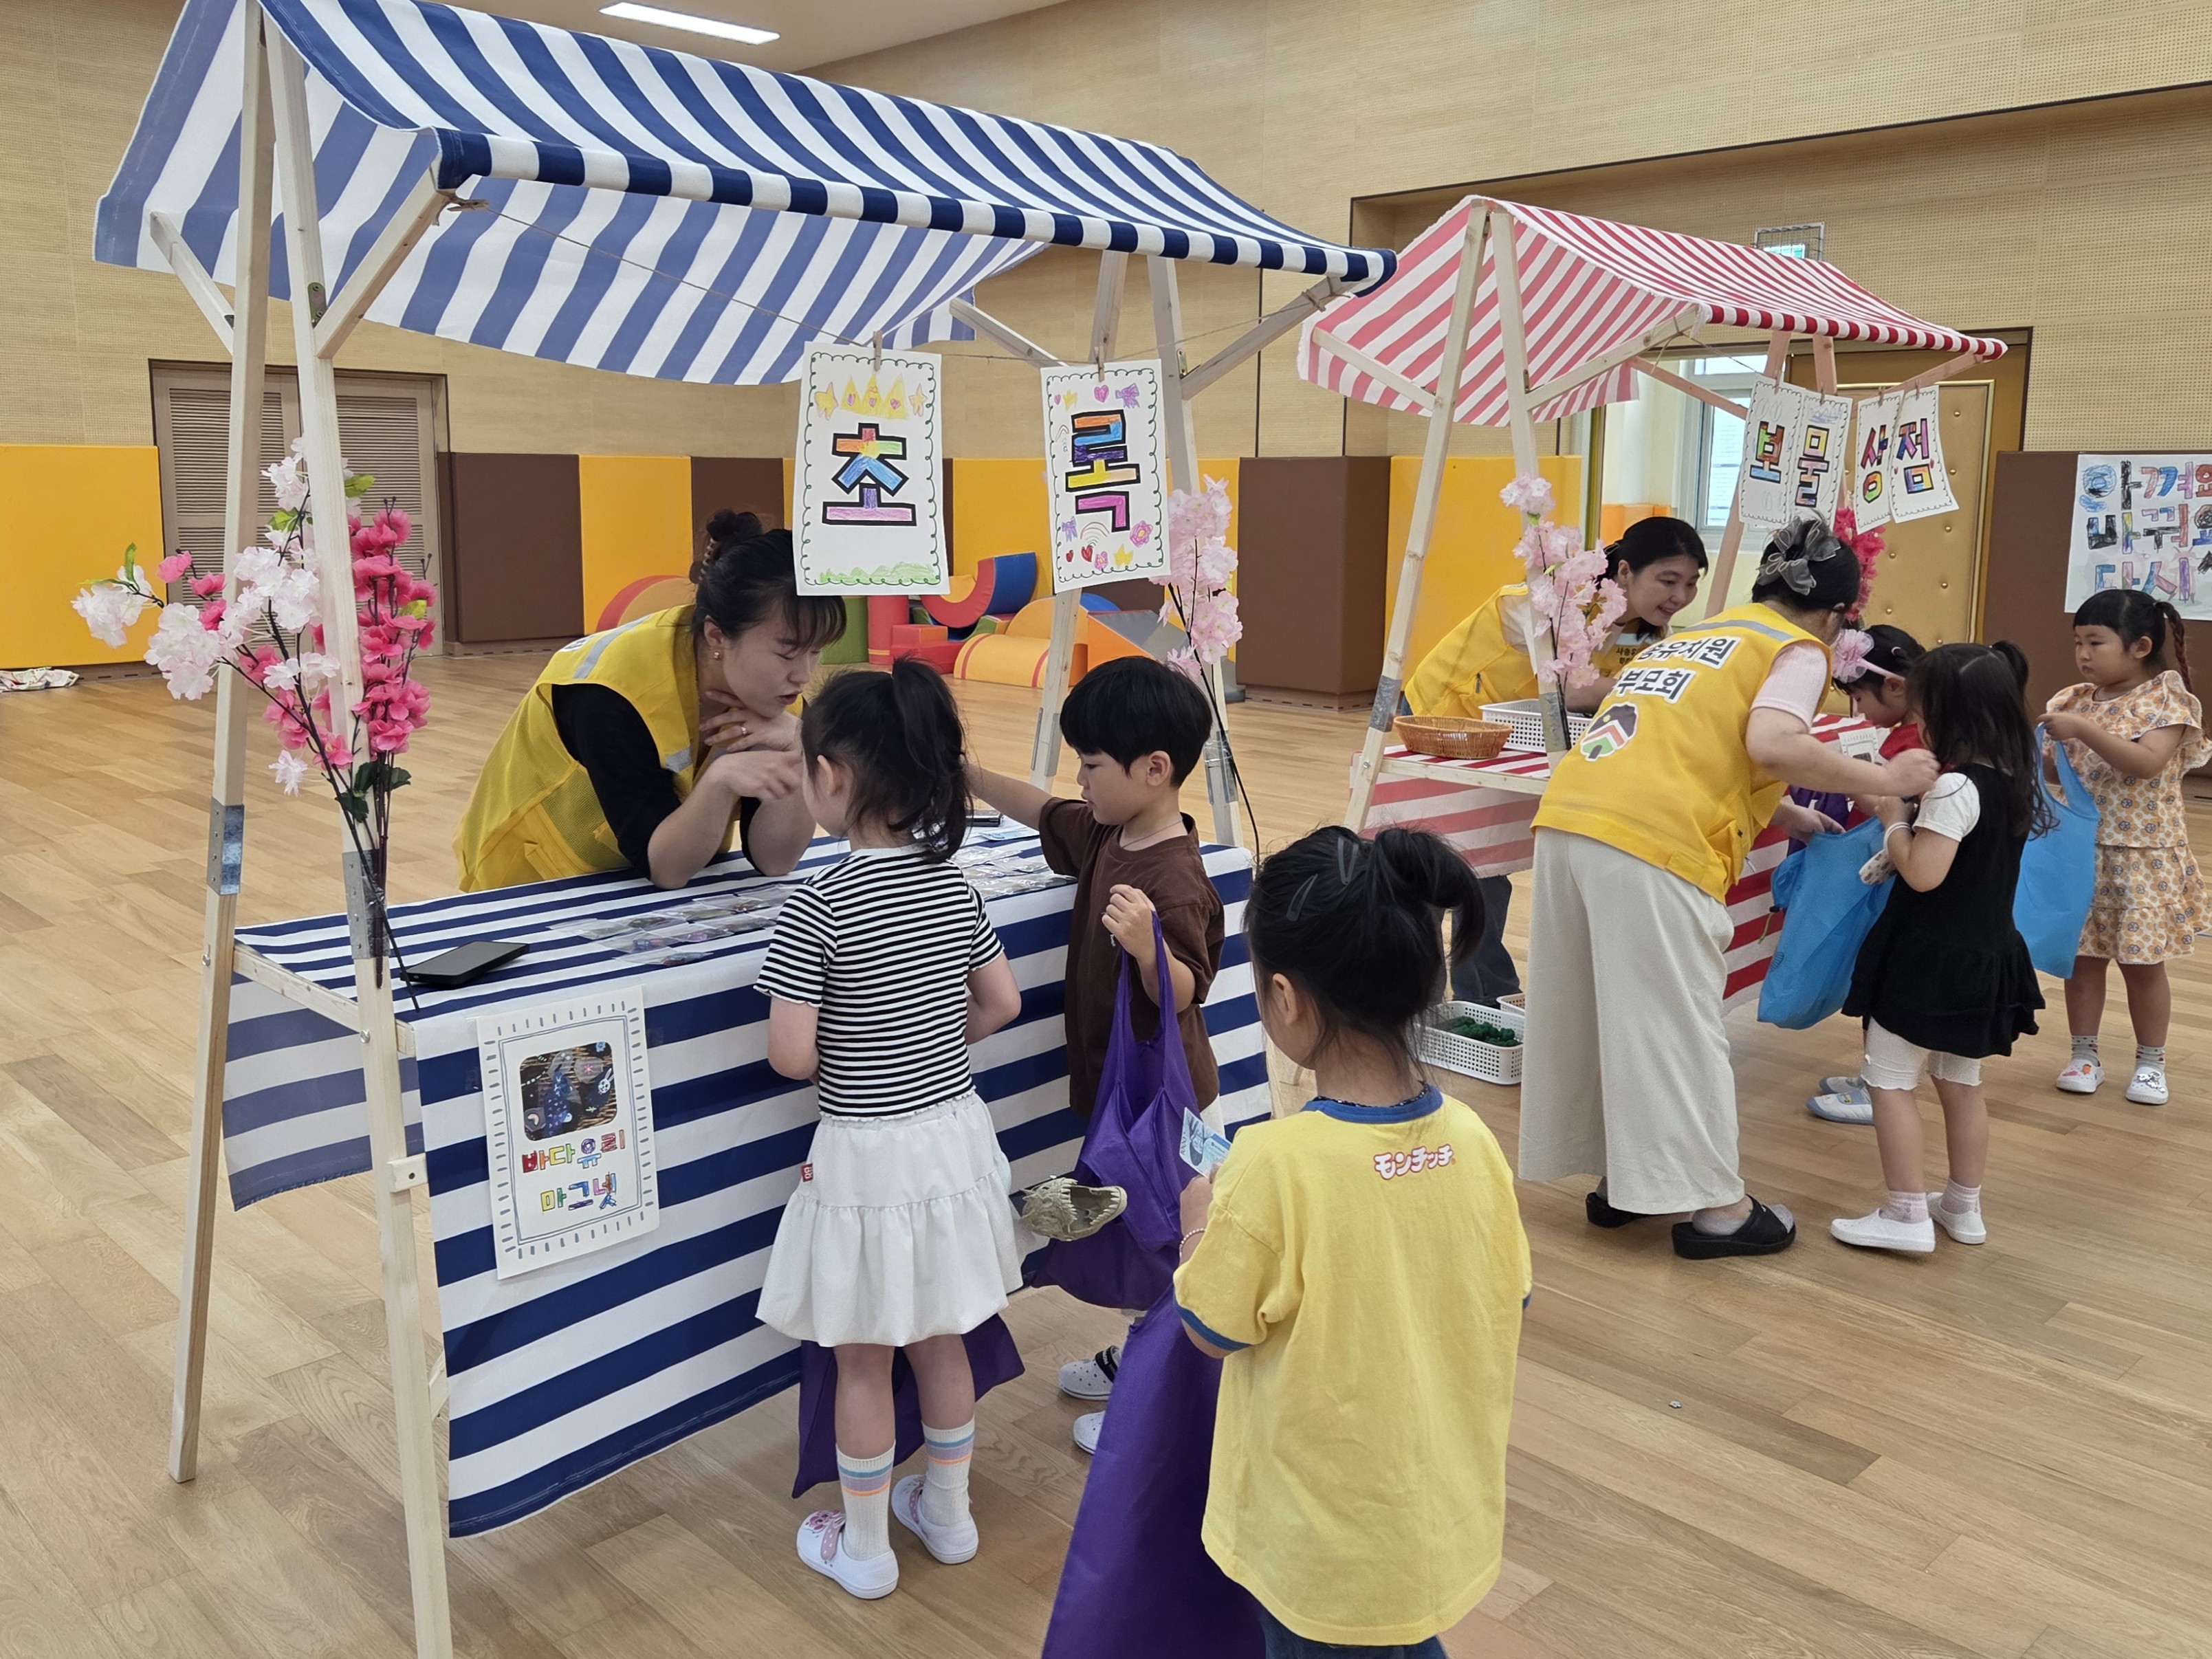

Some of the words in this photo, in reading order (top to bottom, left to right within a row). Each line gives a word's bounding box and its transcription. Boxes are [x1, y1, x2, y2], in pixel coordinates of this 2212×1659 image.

[822, 423, 917, 526] 초
[1861, 418, 1934, 503] 상점
[1617, 669, 1691, 700] 부모회
[1374, 1143, 1454, 1180] モンチッチ
[540, 1172, 617, 1212] 마그넷
